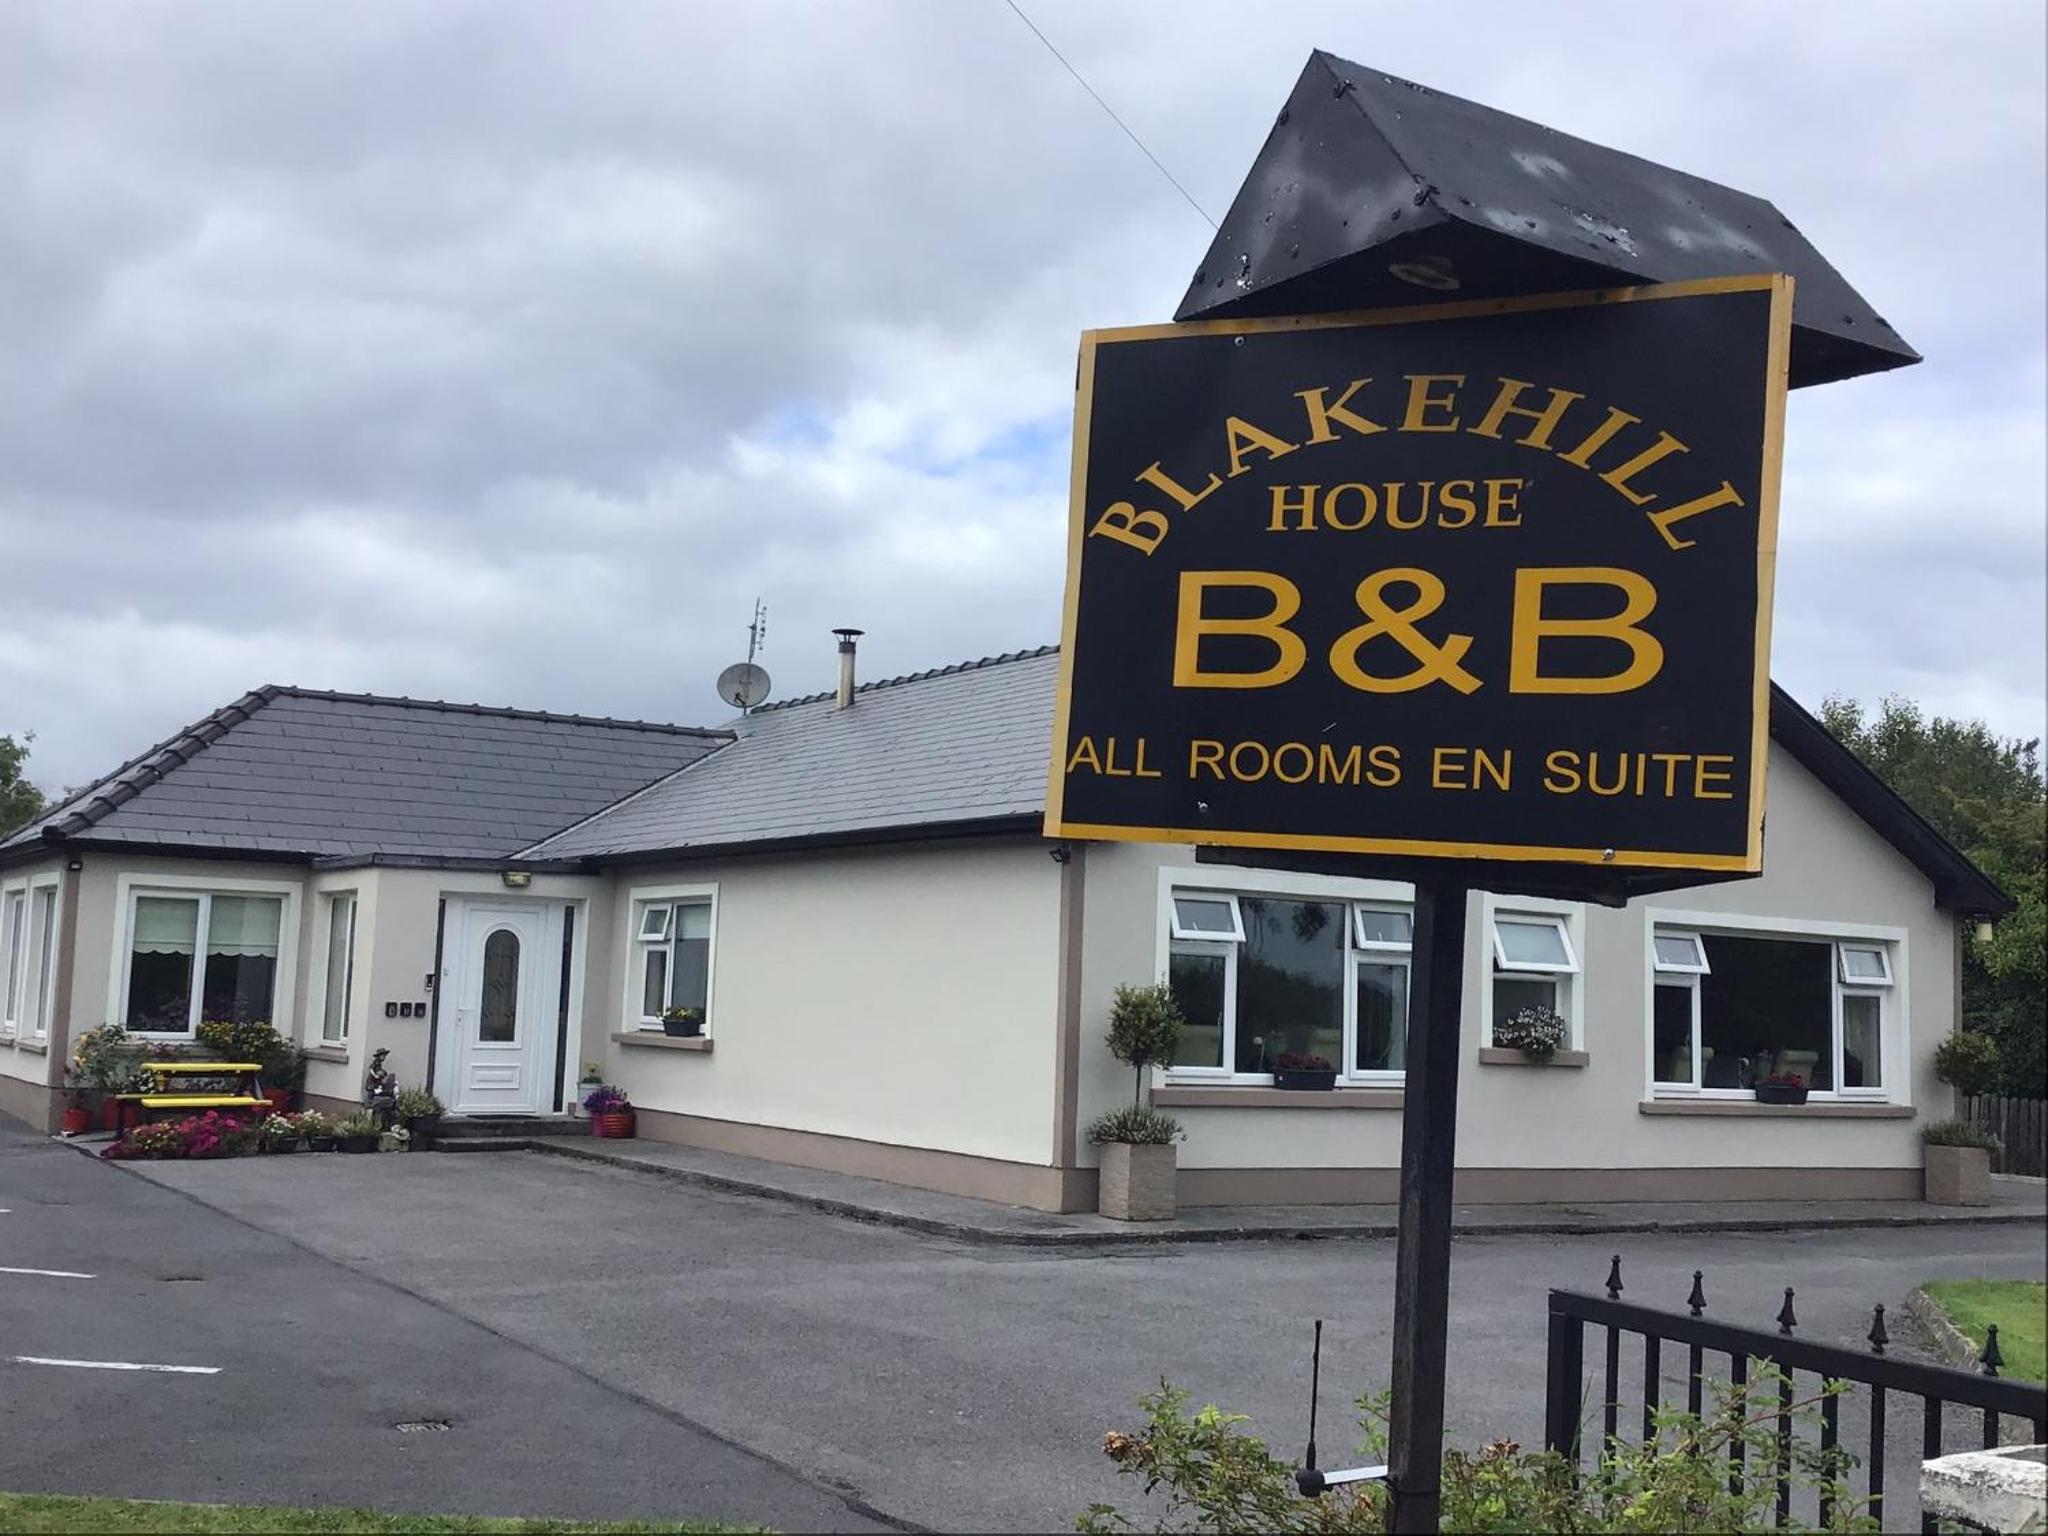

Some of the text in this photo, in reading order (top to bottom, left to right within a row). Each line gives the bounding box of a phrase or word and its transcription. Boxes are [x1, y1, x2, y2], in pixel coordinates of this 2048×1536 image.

[1089, 374, 1745, 556] BLAKEHILL
[1266, 478, 1525, 531] HOUSE
[1171, 566, 1665, 696] B&B
[1066, 737, 1735, 799] ALL ROOMS EN SUITE
